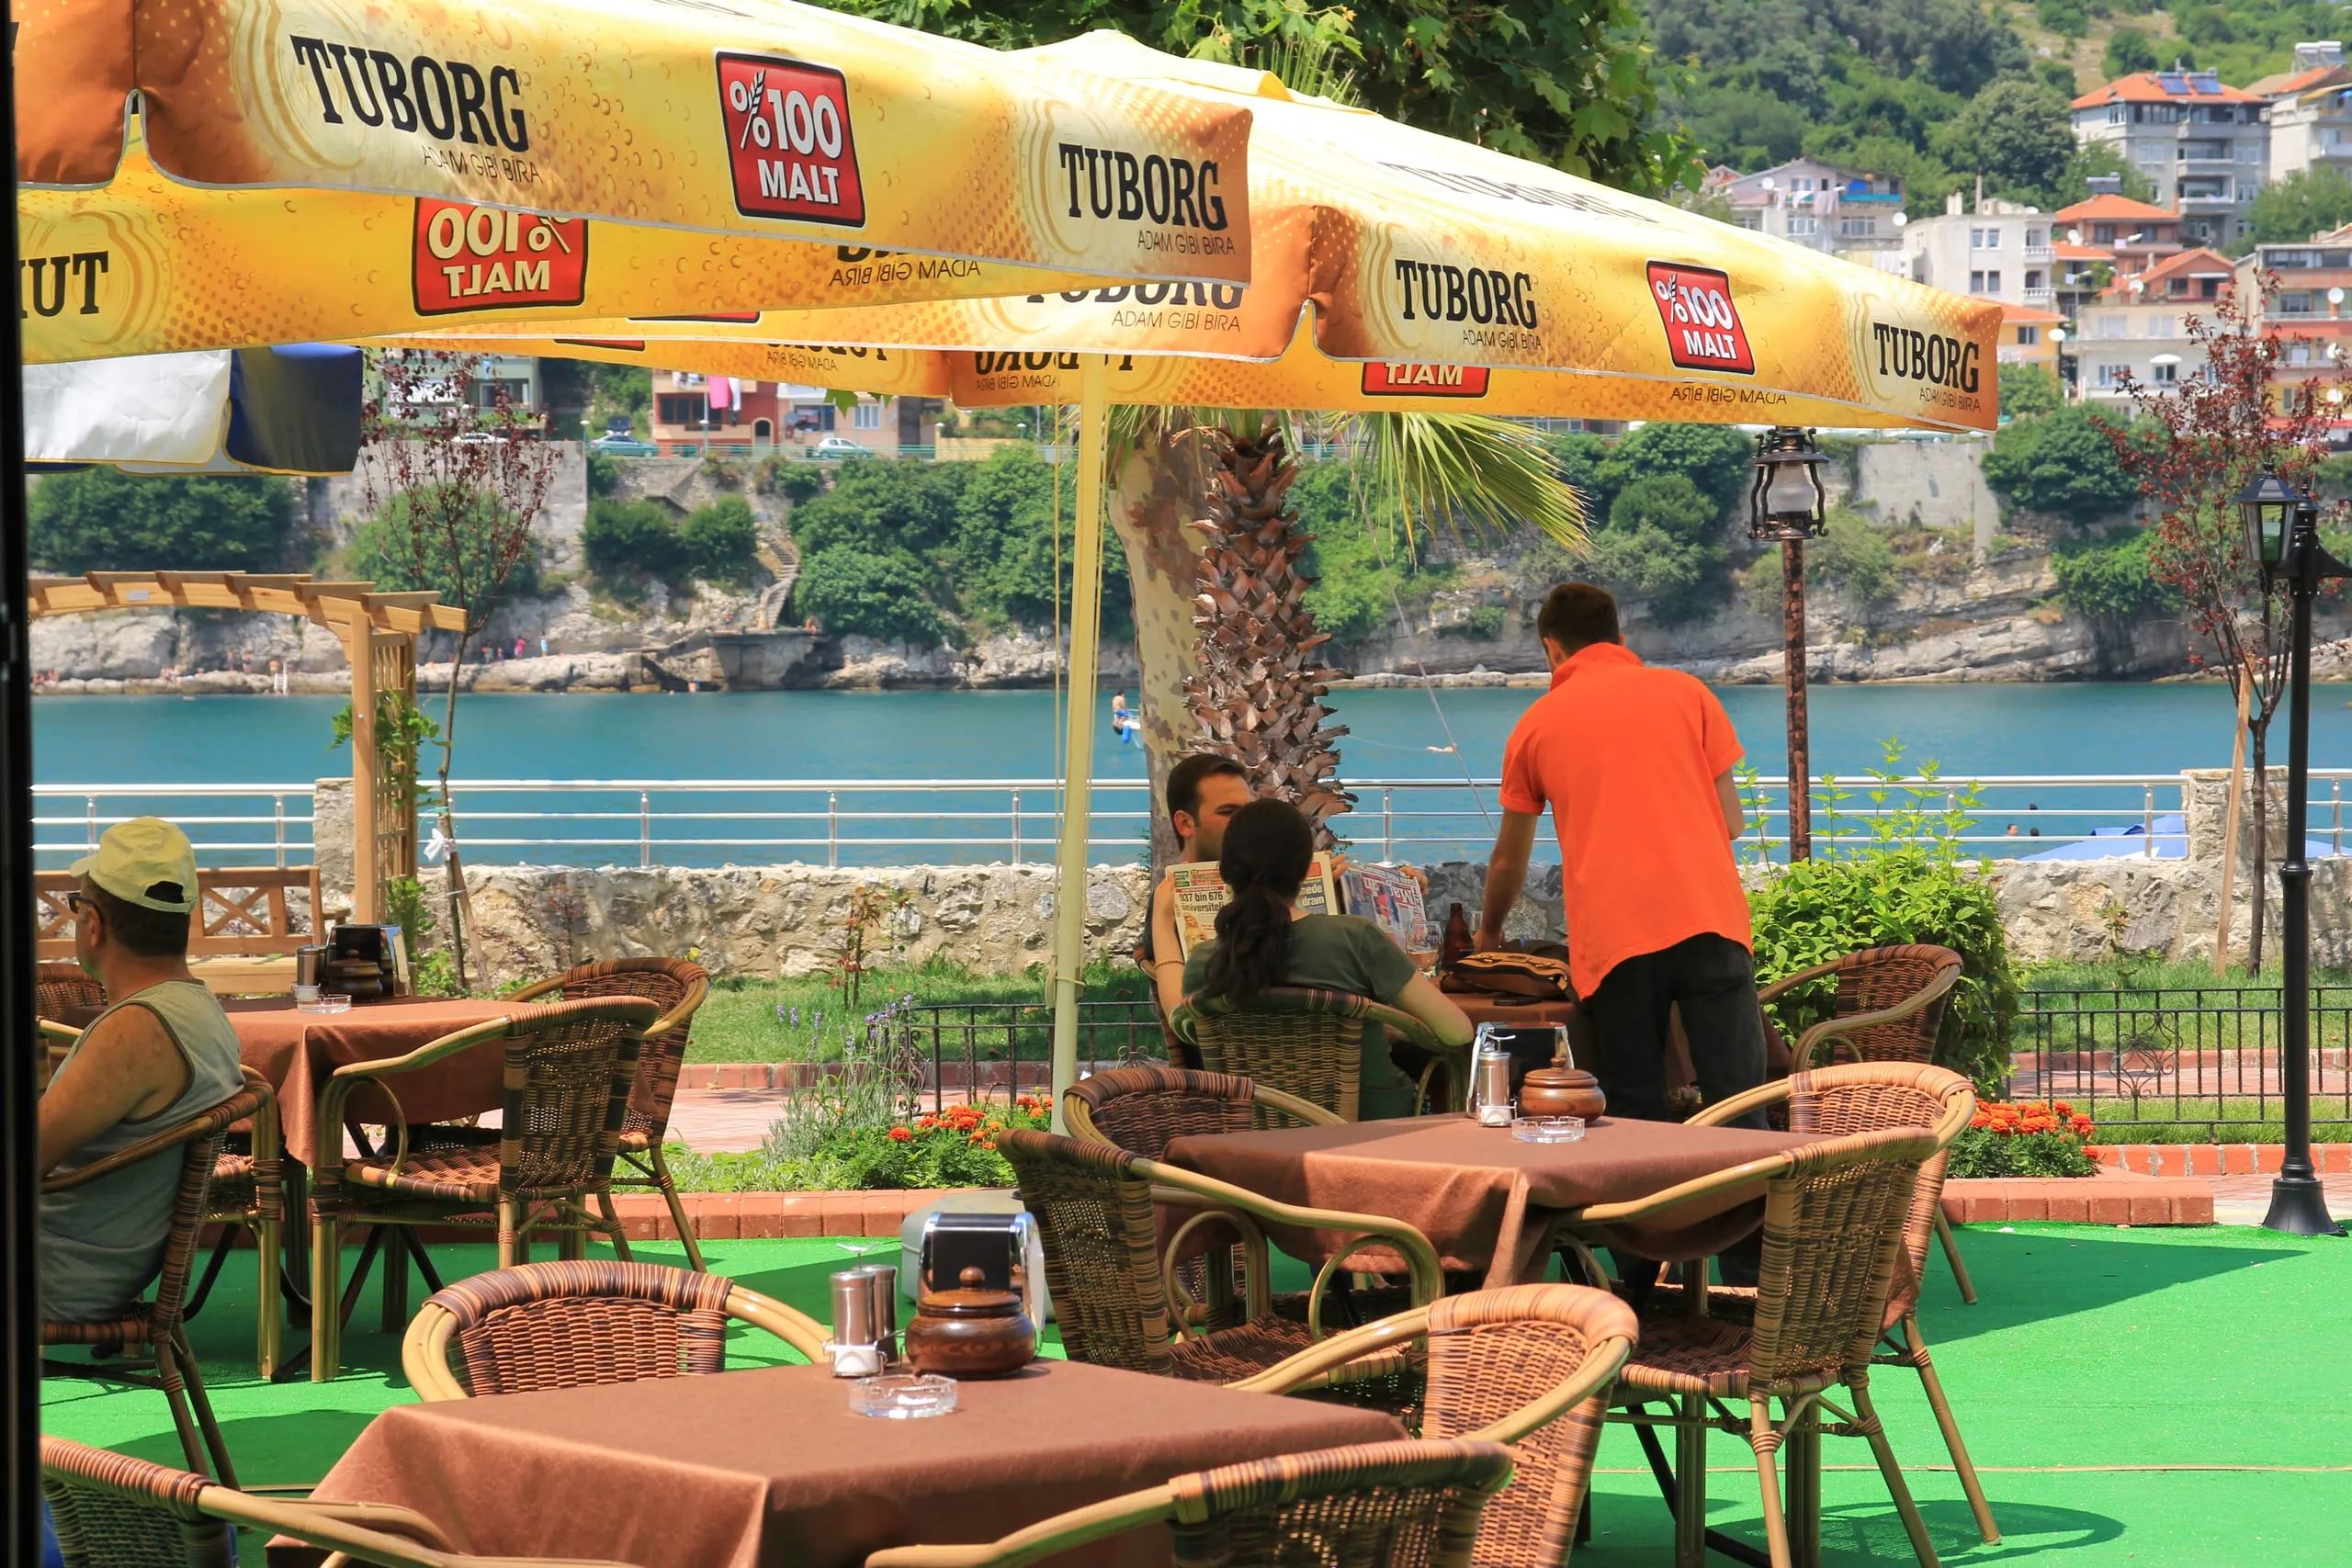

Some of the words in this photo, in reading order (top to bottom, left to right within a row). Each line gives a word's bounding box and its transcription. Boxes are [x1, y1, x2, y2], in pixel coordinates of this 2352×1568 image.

[289, 34, 530, 152] TUBORG
[729, 69, 842, 159] %100
[421, 145, 468, 175] ADAM
[757, 159, 840, 205] MALT
[1058, 142, 1228, 231] TUBORG
[1137, 230, 1173, 253] ADAM
[1174, 231, 1200, 255] GİBİ
[1202, 233, 1236, 255] BİRA
[1395, 258, 1538, 330] TUBORG
[1655, 273, 1734, 331] %100
[1111, 310, 1164, 328] ADAM
[1167, 310, 1200, 329] GİBİ
[1204, 311, 1241, 332] BİRA
[1463, 330, 1496, 347] ADAM
[1682, 329, 1738, 360] MALT
[1872, 321, 1979, 394] TUBORG
[1194, 892, 1207, 902] bin
[1208, 891, 1224, 901] 676
